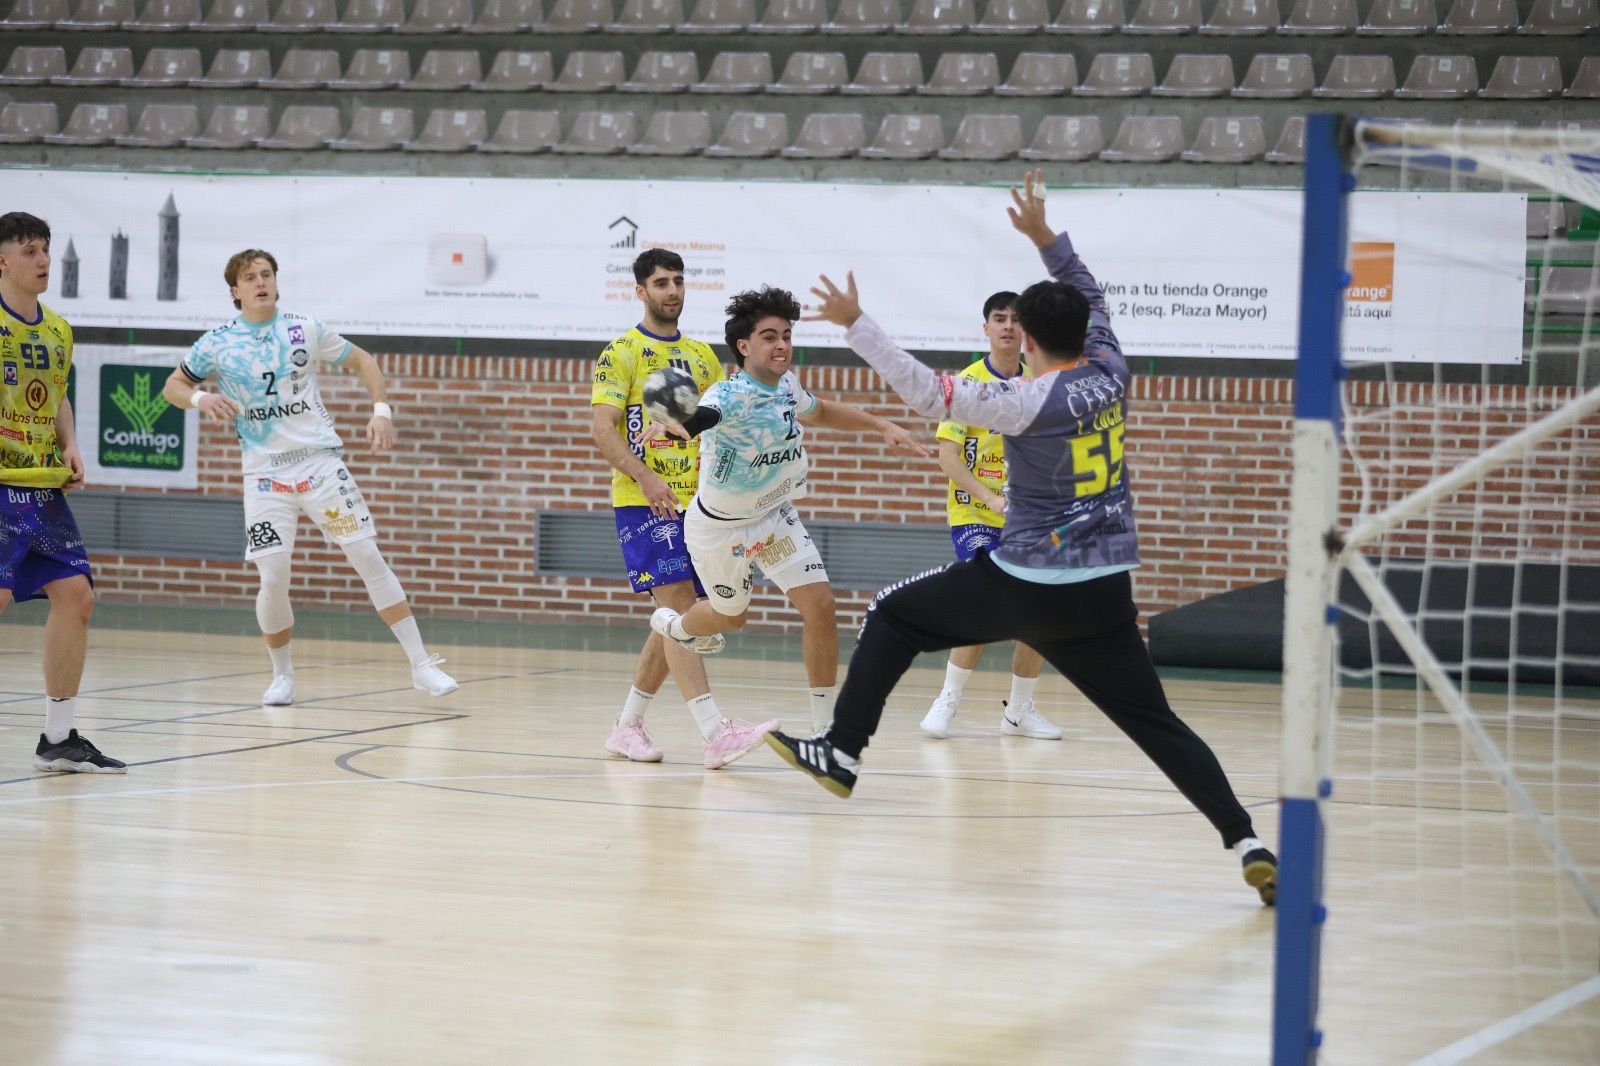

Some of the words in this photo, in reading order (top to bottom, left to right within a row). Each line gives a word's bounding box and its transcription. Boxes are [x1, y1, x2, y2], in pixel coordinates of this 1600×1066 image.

[1099, 282, 1126, 296] Ven
[1130, 285, 1139, 296] a
[1144, 283, 1158, 296] tu
[1163, 283, 1208, 297] tienda
[1213, 283, 1268, 300] Orange
[1345, 285, 1386, 300] range
[1119, 303, 1127, 316] 2
[1132, 303, 1166, 319] (esq.
[1172, 303, 1211, 317] Plaza
[1216, 304, 1267, 320] Mayor)
[1364, 305, 1391, 320] aquí
[21, 343, 50, 370] 93
[262, 372, 278, 396] 2
[595, 371, 607, 383] 16
[103, 427, 180, 454] Contigo
[1068, 422, 1126, 497] 55
